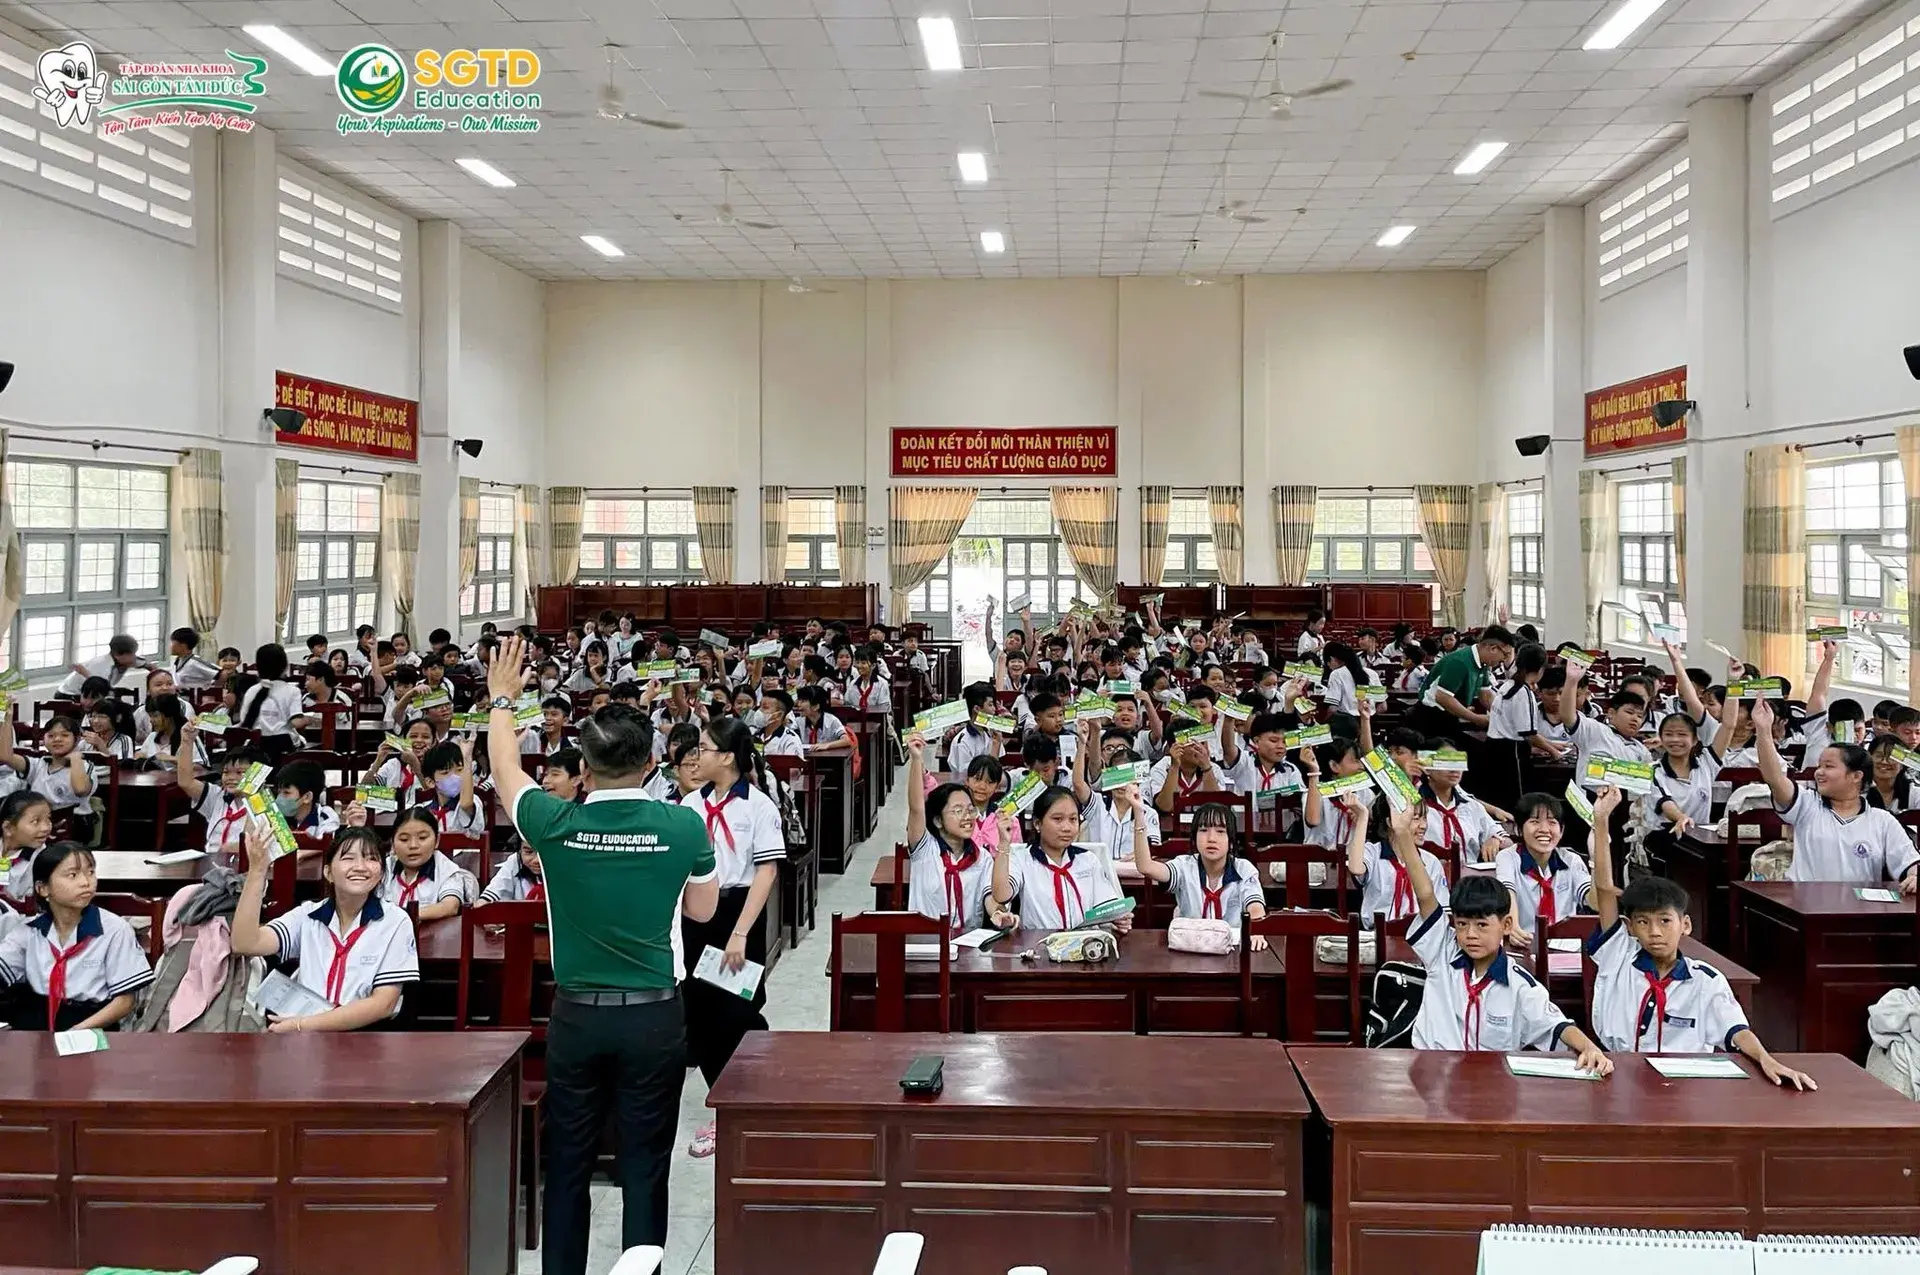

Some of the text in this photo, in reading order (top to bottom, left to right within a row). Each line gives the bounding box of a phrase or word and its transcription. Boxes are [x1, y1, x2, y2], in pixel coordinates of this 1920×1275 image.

[282, 378, 294, 406] ĐỂ
[318, 392, 336, 416] HỌC
[336, 390, 347, 415] ĐỂ
[347, 396, 364, 419] LÀM
[350, 425, 365, 448] HỌC
[900, 430, 1110, 452] ĐOÀN KẾT ĐỔI MỚI THÂN THIỆN VÌ
[902, 451, 1107, 472] MỤC TIÊU CHẤT LƯỢNG GIÁO DỤC
[576, 832, 658, 845] SGTD EUDUCATION
